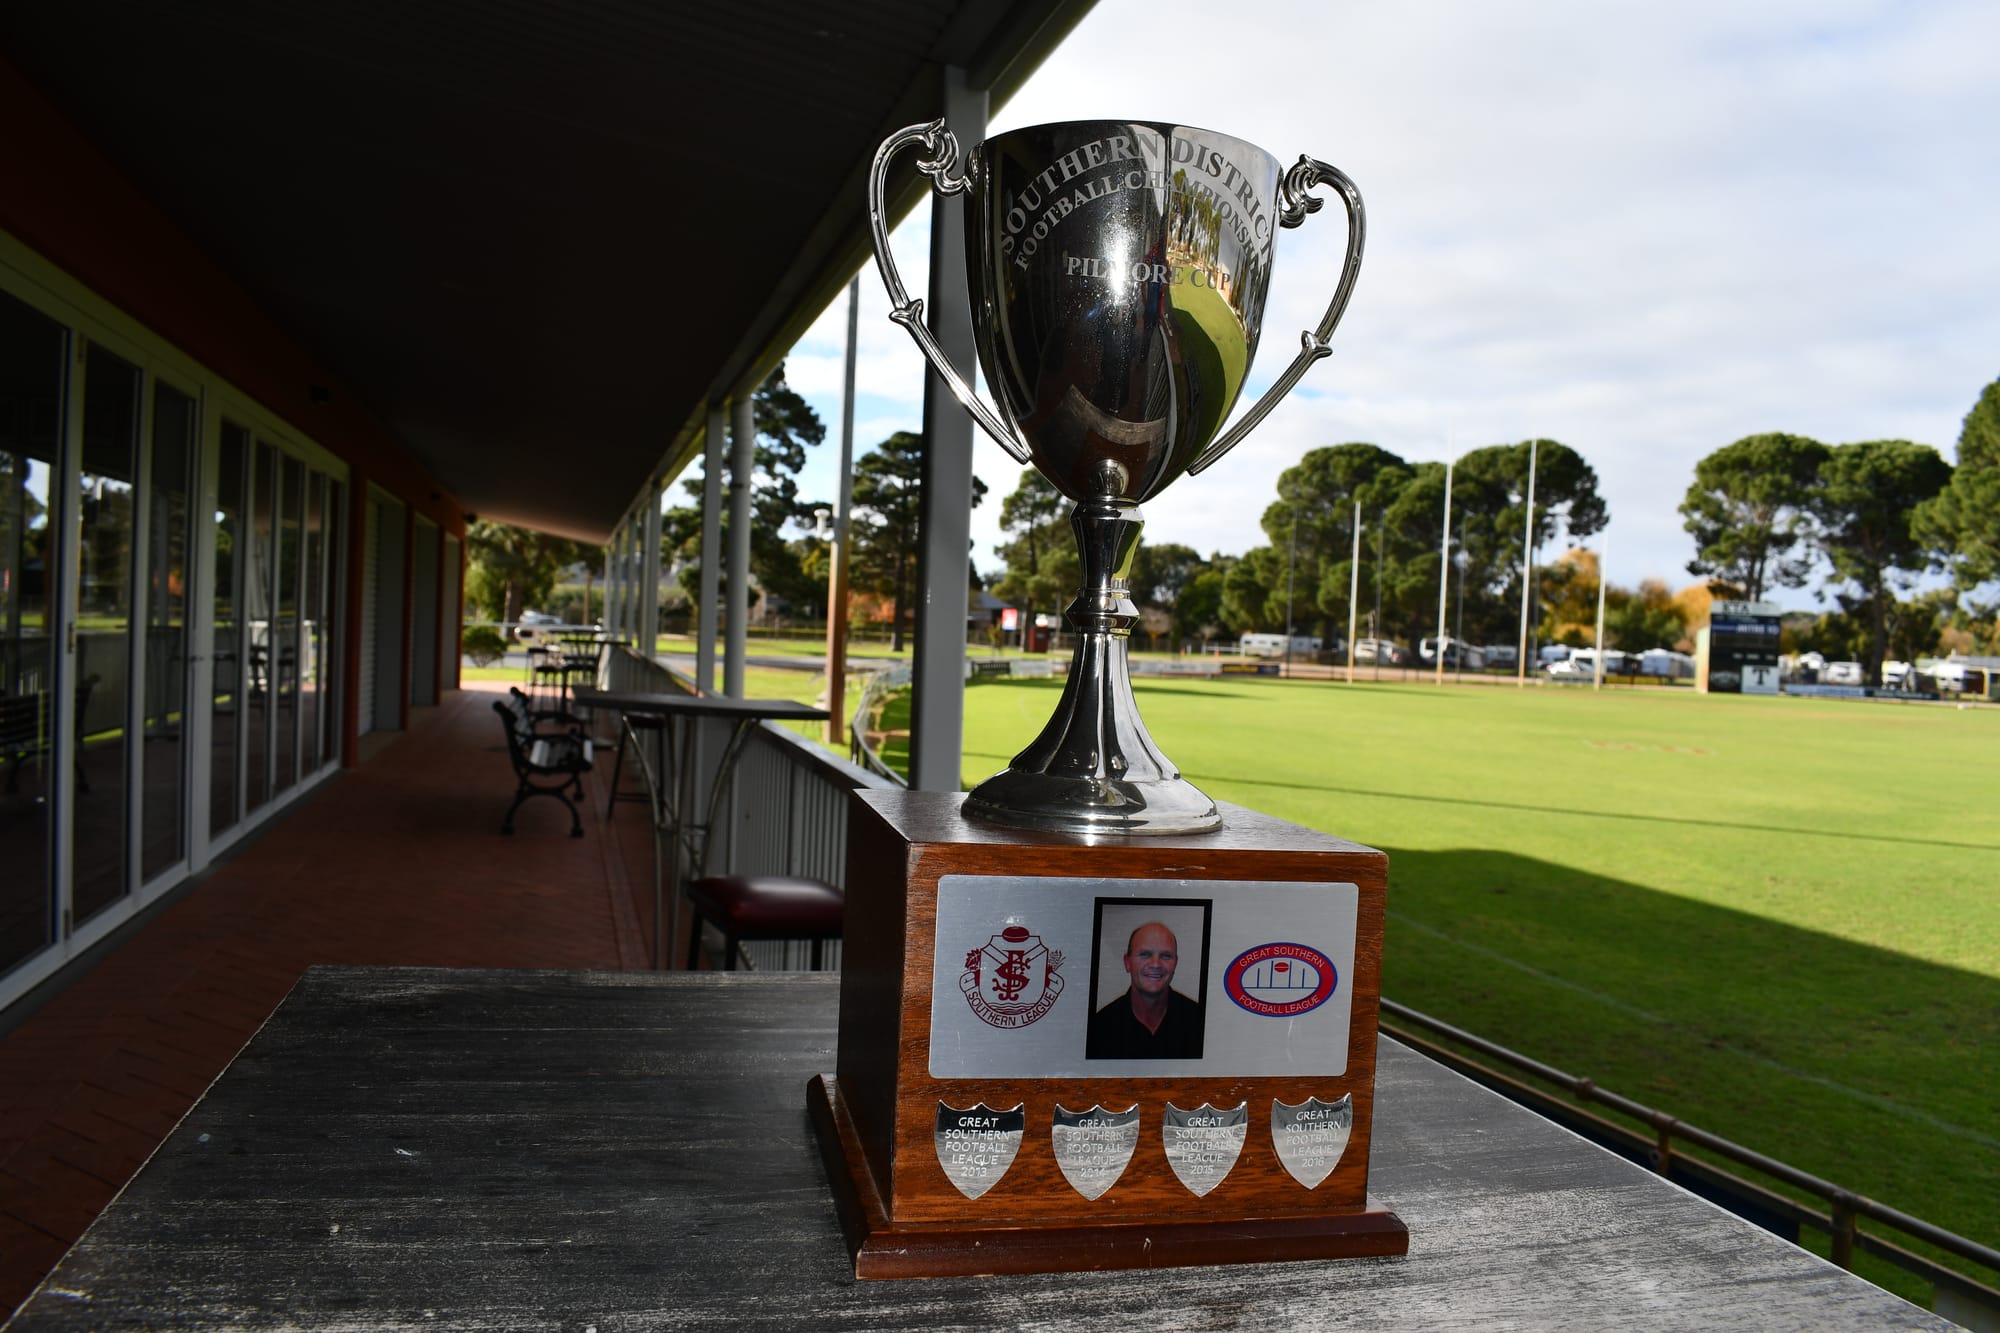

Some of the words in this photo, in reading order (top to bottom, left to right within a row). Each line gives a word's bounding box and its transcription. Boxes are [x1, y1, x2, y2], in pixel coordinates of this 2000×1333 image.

[1000, 132, 1161, 256] SOUTHERN
[1013, 175, 1121, 273] FOOTBALL
[1065, 256, 1184, 286] PILORE
[1190, 268, 1231, 291] CUP
[1239, 946, 1271, 967] GREAT
[1273, 945, 1326, 968] SOUTHERN
[968, 991, 1016, 1027] SOUTHERN
[1021, 991, 1056, 1025] LEAGUE
[1239, 993, 1284, 1014] FOOTBALL
[1285, 994, 1321, 1014] LEAGUE
[1296, 1109, 1332, 1120] GREAT
[958, 1116, 1000, 1128] GREAT
[1078, 1118, 1115, 1129] GREAT
[1187, 1116, 1225, 1127] GREAT
[1285, 1120, 1341, 1133] SOUTHERN
[944, 1128, 1010, 1141] SOUTHERN
[1065, 1131, 1125, 1141] SOUTHERN
[1175, 1129, 1234, 1139] SOUTHERN
[1286, 1132, 1339, 1146] FOOTBALL
[944, 1141, 1008, 1153] FOOTBALL
[1066, 1143, 1122, 1153] FOOTBALL
[1175, 1141, 1233, 1151] FOOTBALL
[1292, 1144, 1333, 1156] LEAGUE
[951, 1154, 999, 1166] LEAGUE
[1073, 1155, 1115, 1166] LEAGUE
[1182, 1152, 1225, 1163] LEAGUE
[1301, 1157, 1325, 1168] 2016
[960, 1166, 988, 1177] 2013
